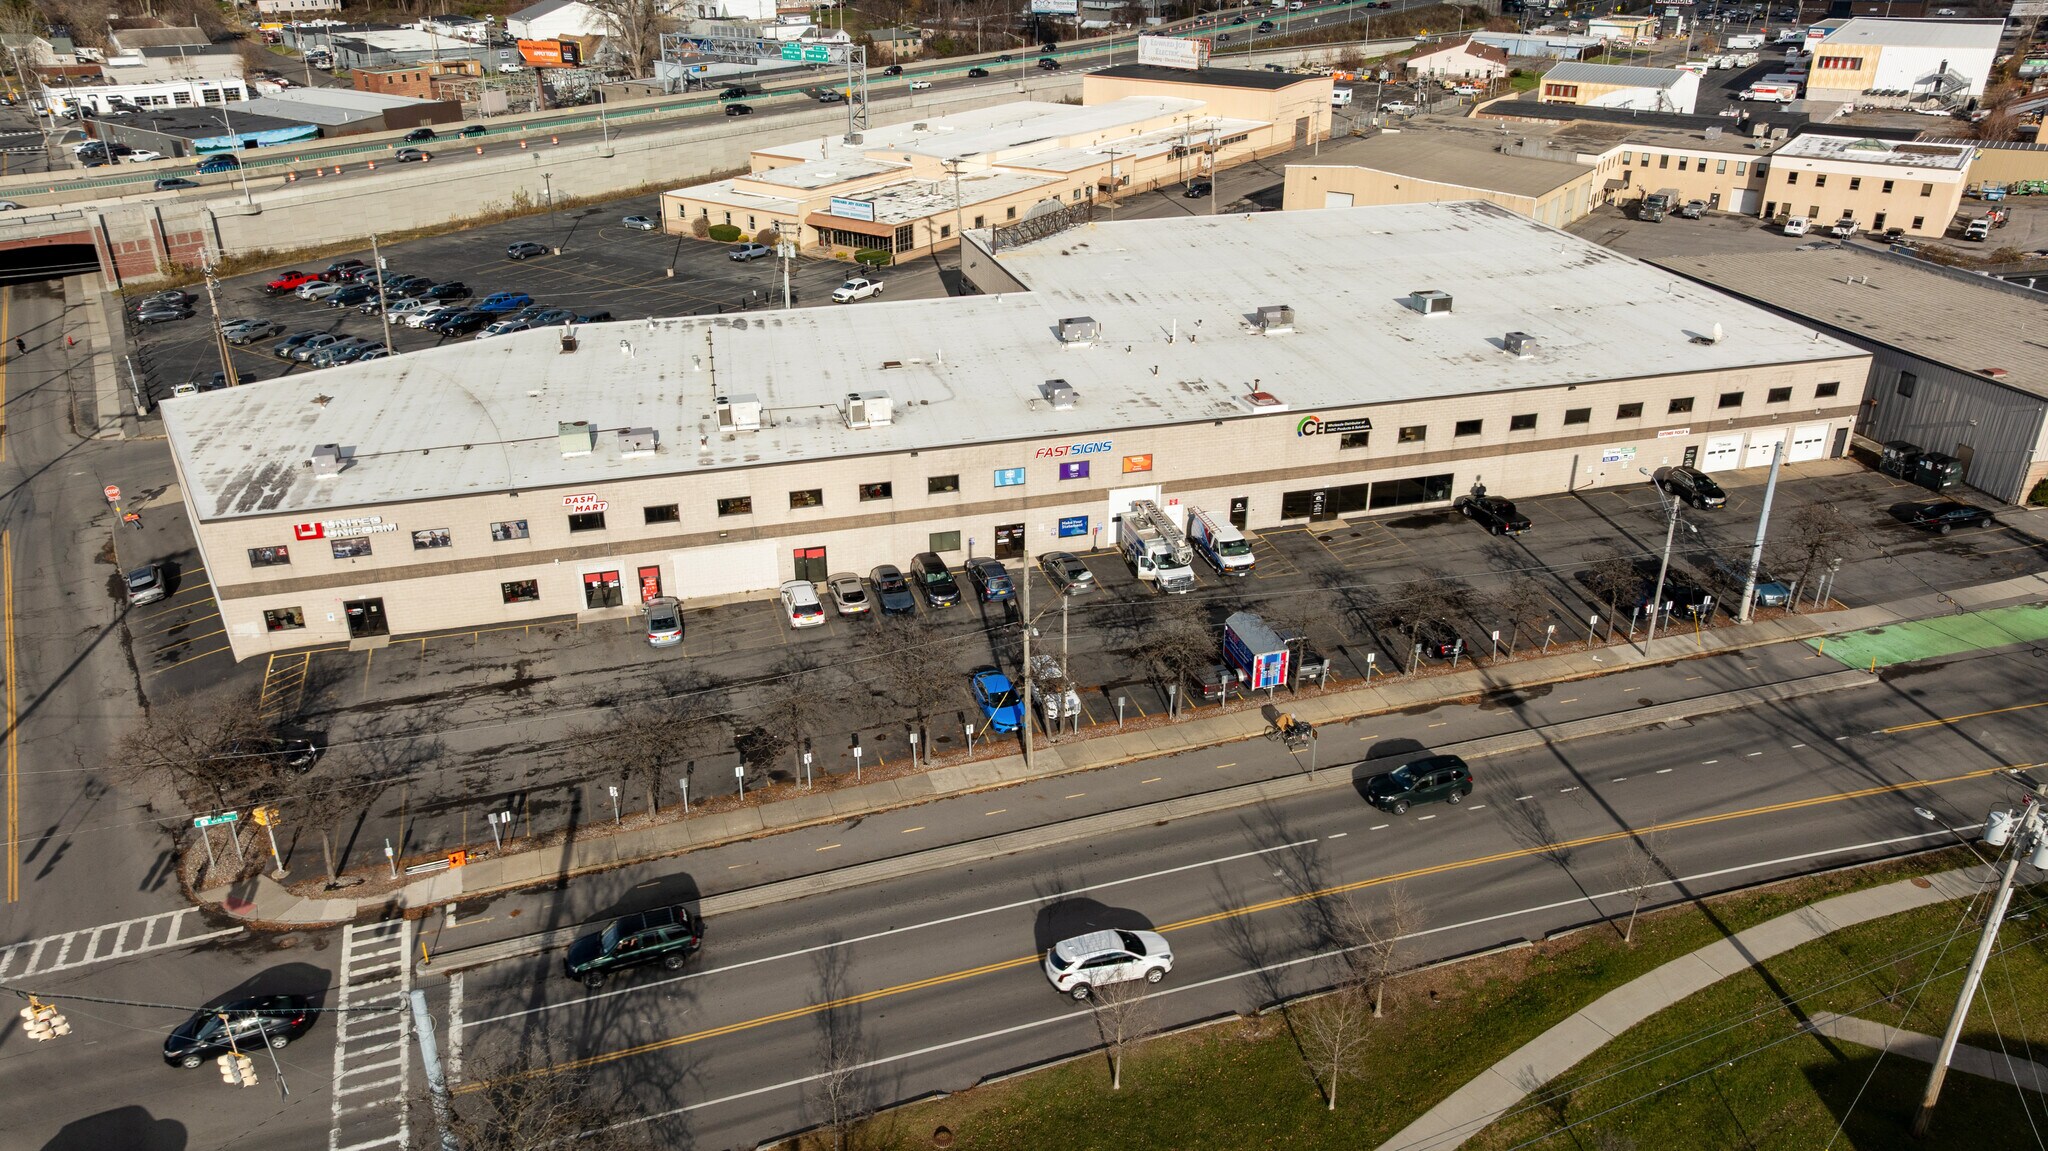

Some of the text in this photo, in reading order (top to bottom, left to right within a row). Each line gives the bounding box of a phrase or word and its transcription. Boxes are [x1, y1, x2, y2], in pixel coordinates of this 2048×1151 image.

[1035, 441, 1113, 459] FASTSIGNS
[565, 495, 594, 505] DASH
[575, 503, 606, 512] MART
[325, 516, 382, 529] UNITED
[326, 523, 399, 538] UNIFORM
